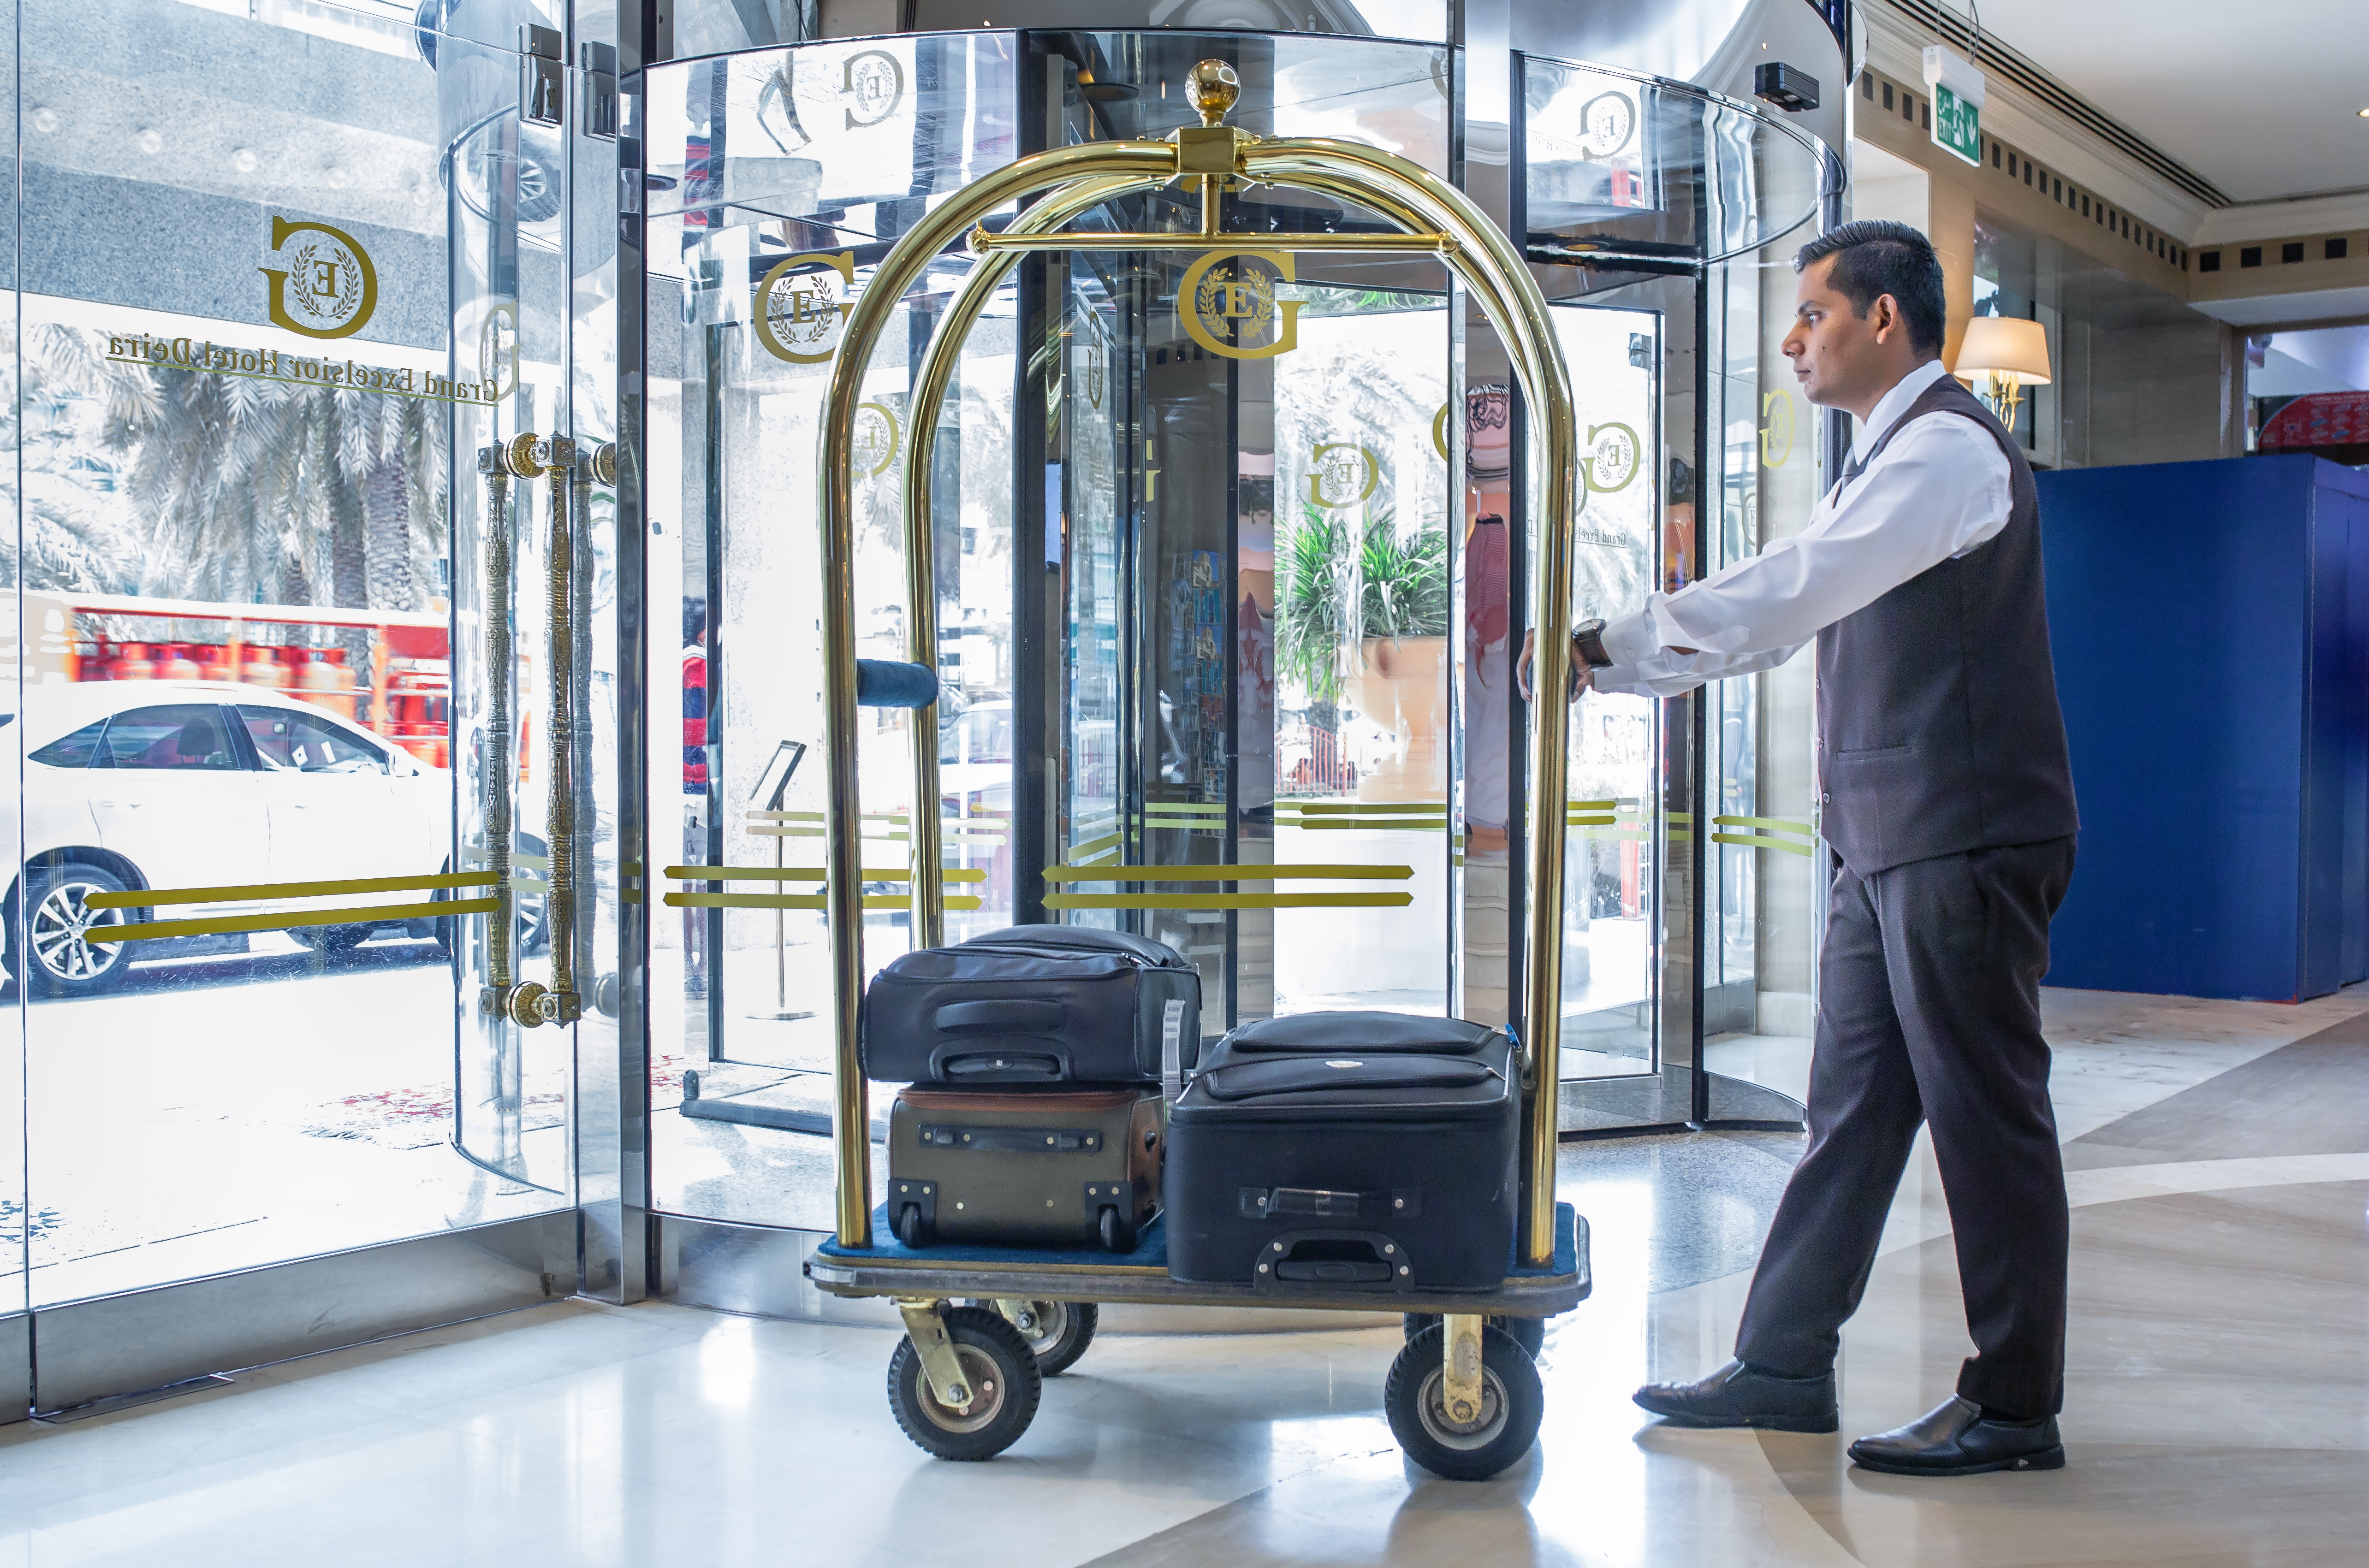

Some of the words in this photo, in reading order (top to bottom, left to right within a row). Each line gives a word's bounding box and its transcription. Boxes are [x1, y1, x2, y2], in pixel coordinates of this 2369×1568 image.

[1938, 116, 1952, 142] EXIT
[754, 251, 855, 364] G
[790, 290, 816, 324] E
[1178, 250, 1309, 359] G
[1222, 282, 1253, 317] E
